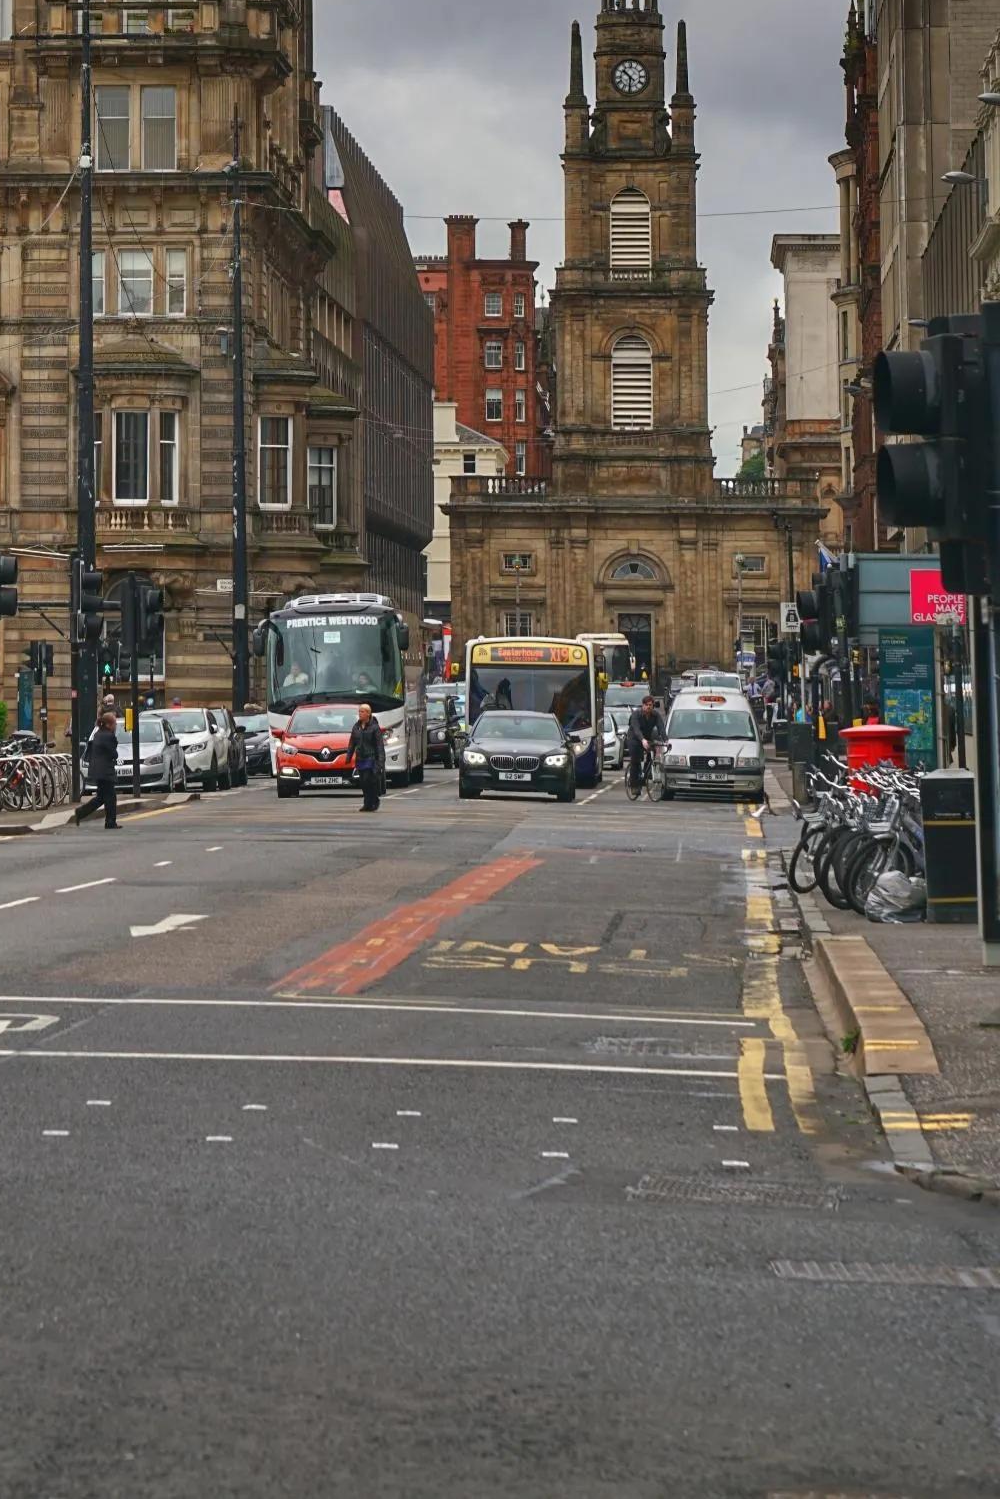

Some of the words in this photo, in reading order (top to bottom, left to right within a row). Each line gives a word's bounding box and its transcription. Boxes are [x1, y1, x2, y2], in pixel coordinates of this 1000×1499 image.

[927, 594, 963, 603] PEOPLE
[935, 604, 964, 613] MAKE
[287, 616, 327, 629] PRENTICE
[329, 615, 378, 626] WESTWOOD
[913, 613, 963, 622] GLAS
[550, 647, 569, 662] X19
